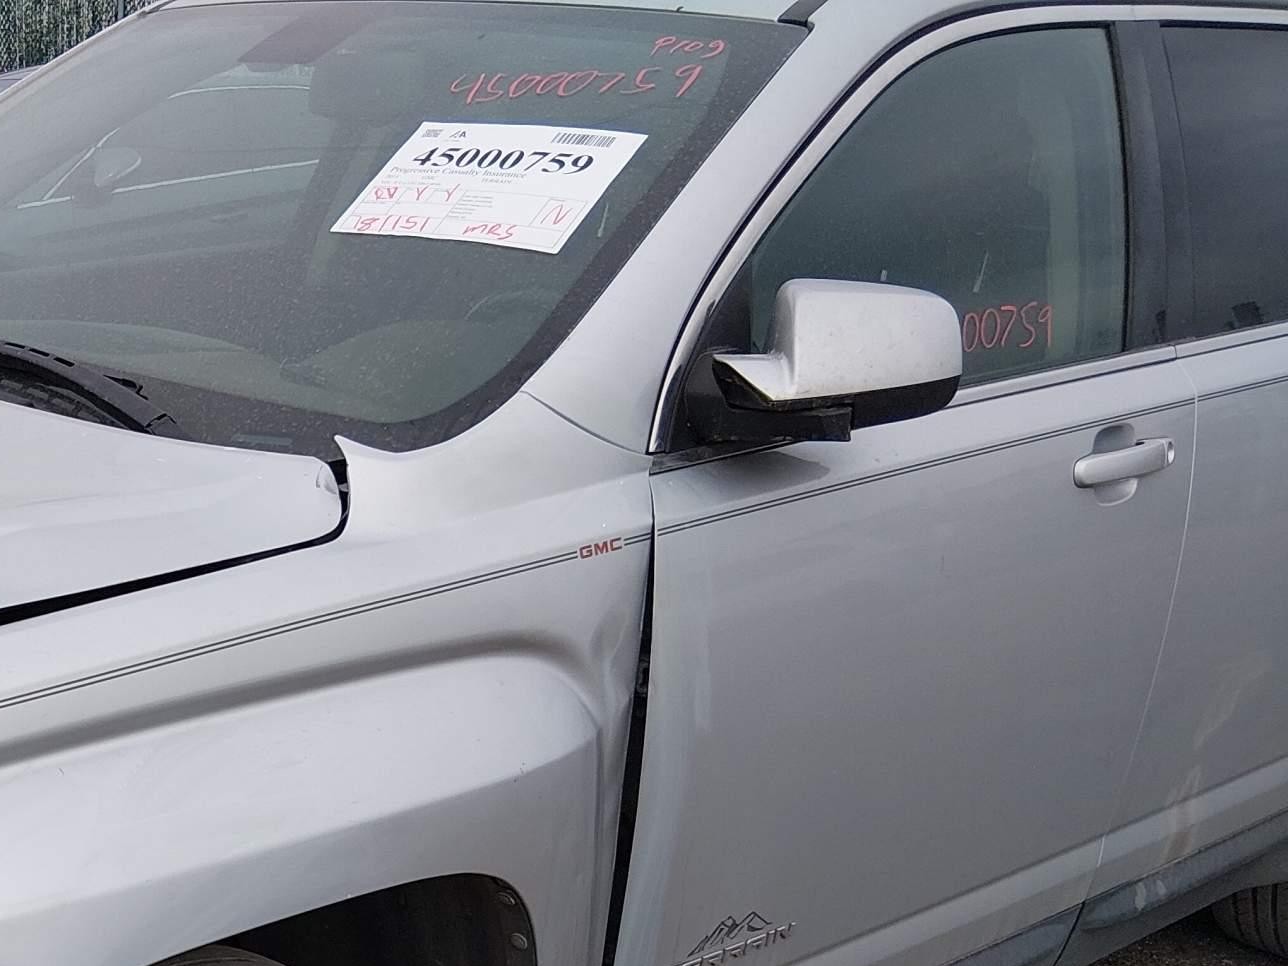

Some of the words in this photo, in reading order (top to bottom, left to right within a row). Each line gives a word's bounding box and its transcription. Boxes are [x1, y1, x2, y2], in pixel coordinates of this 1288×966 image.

[450, 63, 704, 105] 45000759
[390, 166, 441, 174] Progressive
[442, 168, 479, 177] Casualty
[482, 169, 528, 180] Insurance
[412, 146, 595, 175] 45000759
[961, 301, 1053, 353] 00759
[579, 536, 623, 559] GMC
